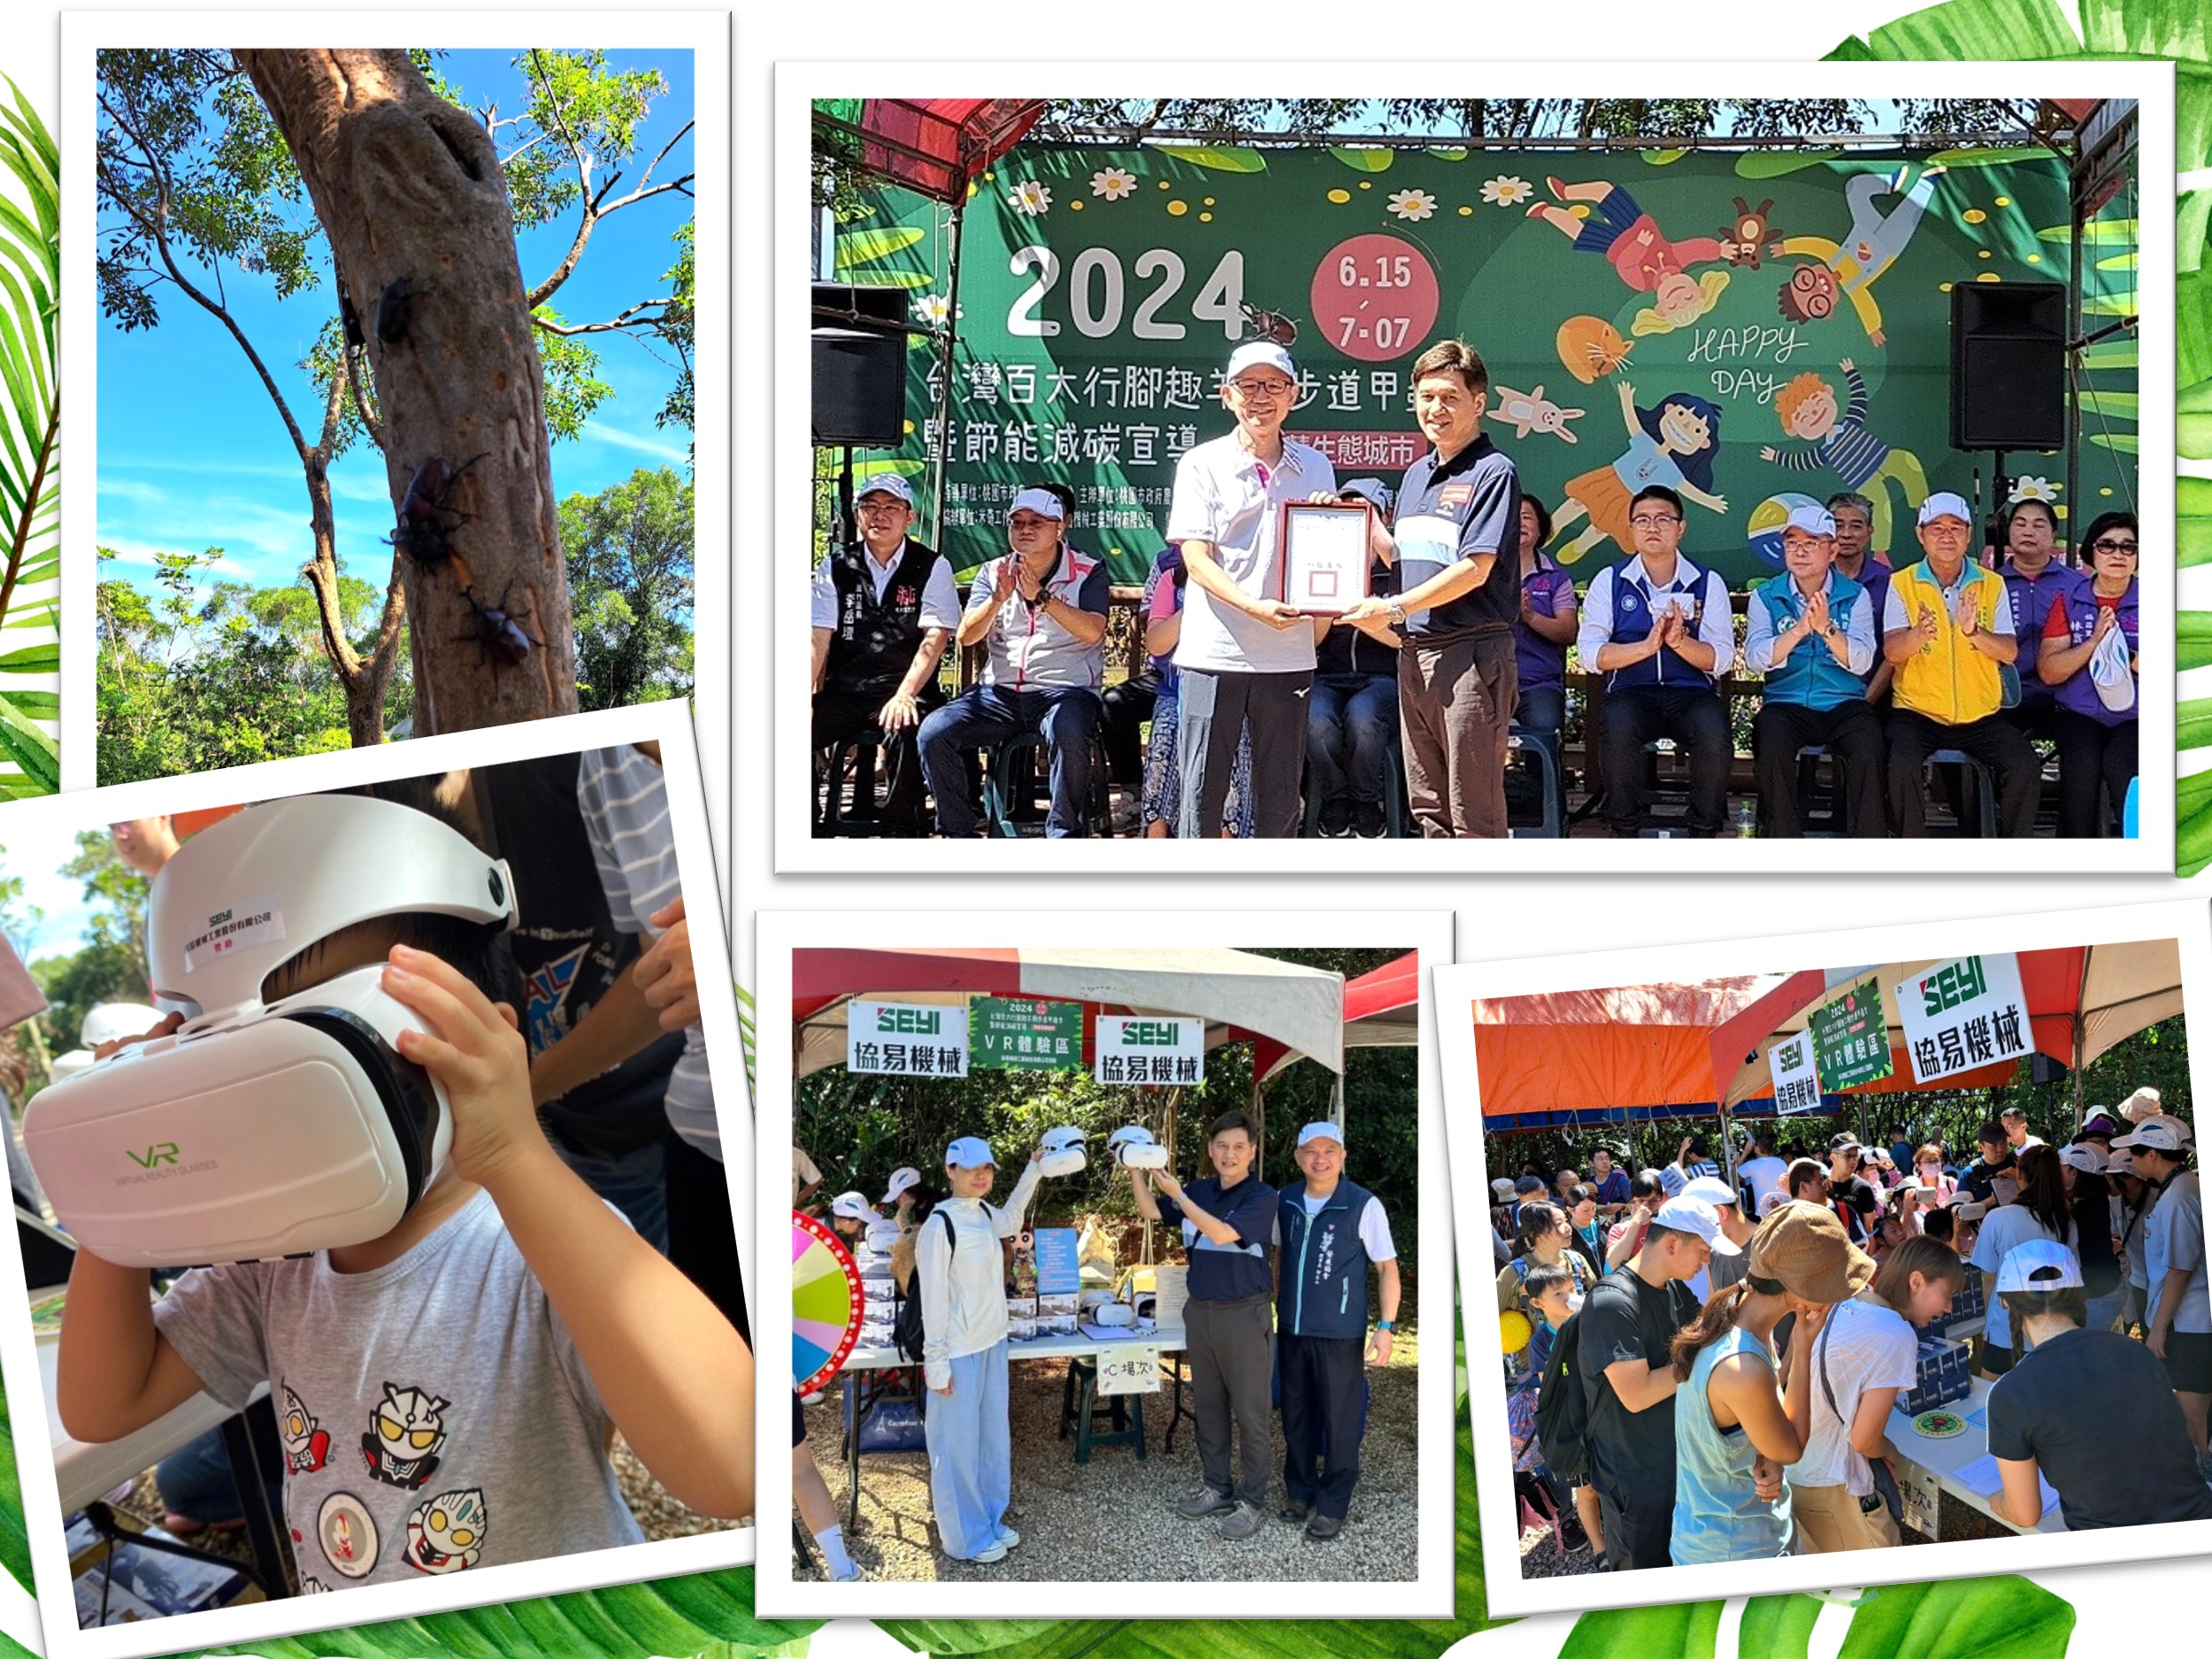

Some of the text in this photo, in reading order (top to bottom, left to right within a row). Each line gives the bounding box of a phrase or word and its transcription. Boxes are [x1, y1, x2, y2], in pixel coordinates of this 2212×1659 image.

[1338, 255, 1412, 288] 6.15
[1007, 245, 1244, 341] 2024
[209, 909, 232, 927] SEYI
[1918, 955, 1987, 1018] SEYI
[876, 1007, 941, 1035] SEYI
[1009, 1003, 1033, 1012] 2024
[1121, 1021, 1179, 1046] SEYI
[1915, 1003, 2025, 1079] 協易機械
[855, 1041, 962, 1074] 協易機械
[1102, 1055, 1198, 1085] 協易機械
[1779, 1040, 1803, 1073] SEYI
[1777, 1079, 1817, 1113] 協易機械
[126, 1142, 180, 1169] VR
[146, 1167, 178, 1183] REALITY
[178, 1159, 219, 1176] GLASSES
